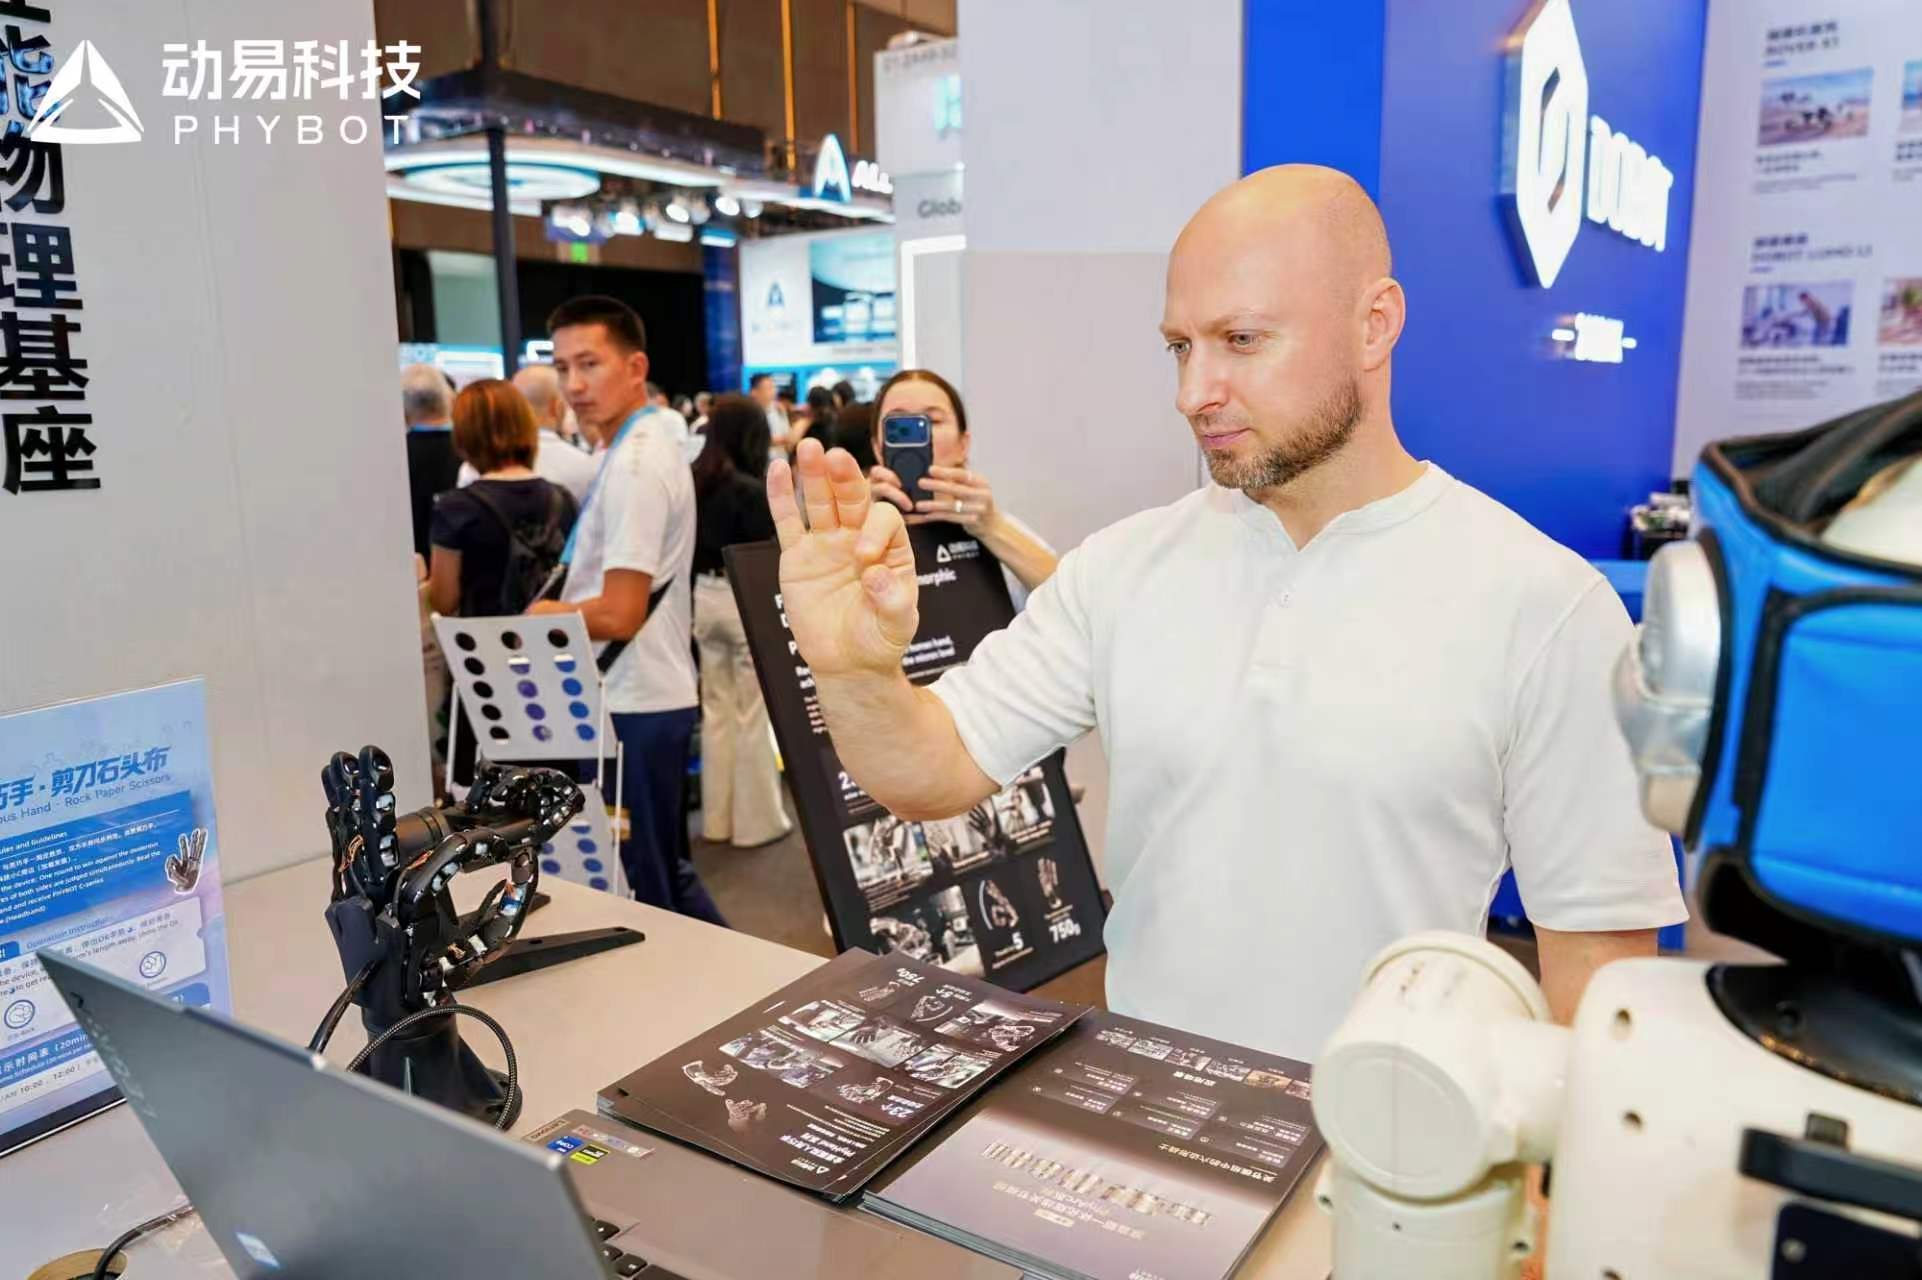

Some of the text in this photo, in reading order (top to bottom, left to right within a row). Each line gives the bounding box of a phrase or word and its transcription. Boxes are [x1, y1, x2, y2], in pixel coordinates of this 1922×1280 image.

[21, 803, 51, 818] Hand
[65, 795, 91, 807] Rock
[95, 786, 126, 800] Paper
[130, 773, 171, 791] Scissors
